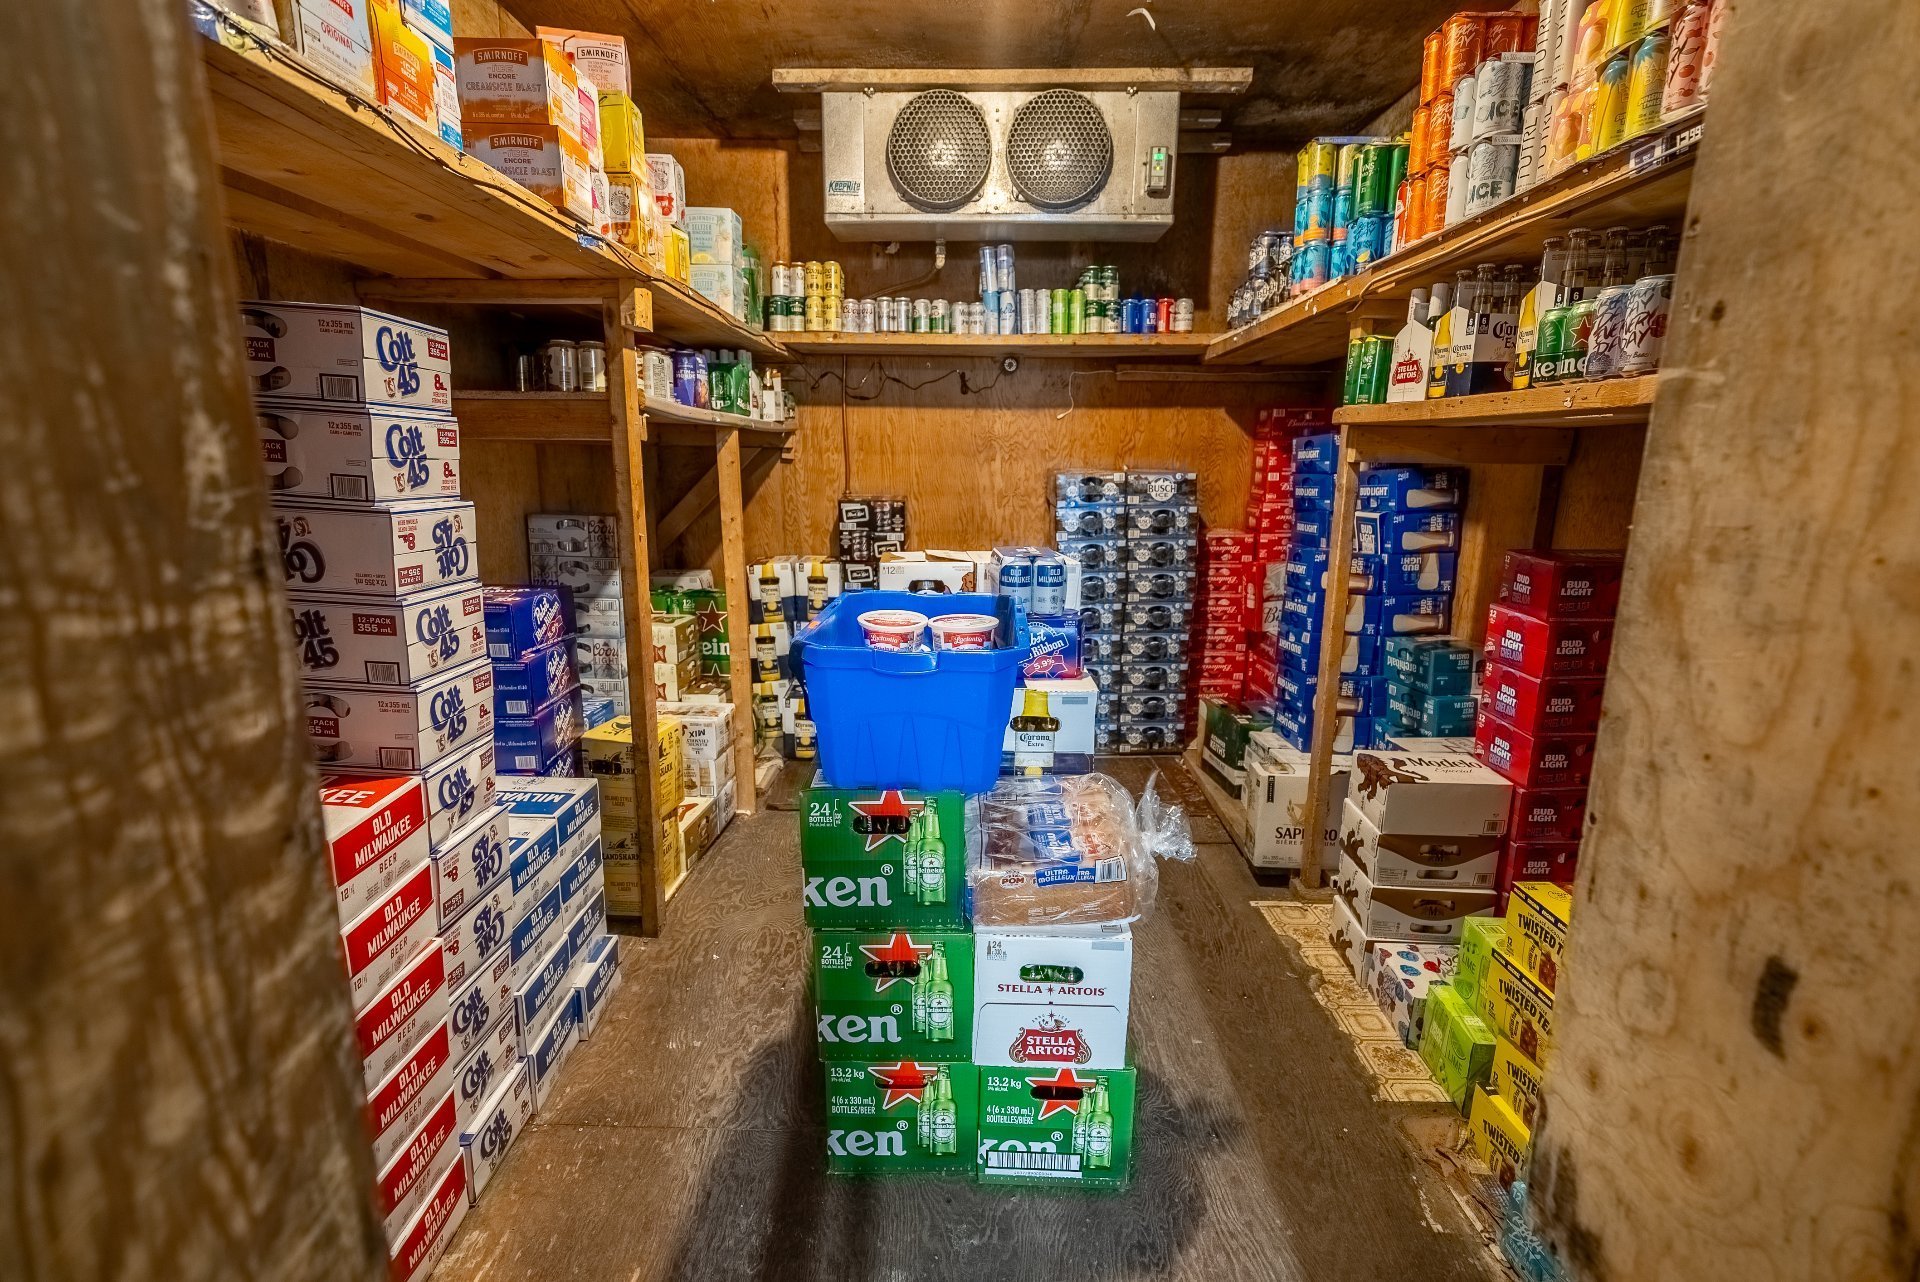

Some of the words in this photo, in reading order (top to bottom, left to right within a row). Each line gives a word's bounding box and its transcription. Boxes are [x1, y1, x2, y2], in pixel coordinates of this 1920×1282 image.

[478, 50, 523, 62] SMIRNOFF
[581, 50, 618, 60] SMIRNOFF
[516, 83, 542, 92] BLAST
[493, 135, 538, 147] SMIRNOFF
[530, 167, 556, 177] BLAST
[1472, 180, 1502, 203] ICE
[1574, 292, 1579, 300] 6
[376, 326, 416, 372] Colt
[1452, 344, 1472, 353] Corona
[1396, 372, 1416, 380] ARTOIS
[1398, 364, 1417, 372] STELLA
[398, 362, 420, 397] 45
[386, 424, 425, 468] Colt
[1298, 450, 1307, 459] BUD
[1306, 450, 1319, 458] LIGHT
[407, 454, 430, 490] 45
[1148, 484, 1176, 492] BUSCH
[1370, 487, 1388, 495] LIGHT
[432, 516, 453, 554] 45
[1361, 524, 1372, 534] BUD
[1360, 533, 1375, 543] LIGHT
[437, 537, 468, 579] Colt
[1002, 575, 1030, 583] MILWAUKEE
[358, 624, 378, 632] 355
[417, 604, 453, 646] Colt
[1506, 630, 1521, 641] BUD
[439, 628, 459, 662] 45
[1032, 640, 1064, 658] Ribbon
[1502, 638, 1523, 652] LIGHT
[304, 638, 339, 670] 45
[1034, 658, 1054, 671] 5.9%
[1501, 684, 1515, 697] BUD
[430, 685, 463, 731] Colt
[1497, 692, 1517, 707] LIGHT
[689, 729, 706, 738] MIX
[1020, 733, 1051, 743] Corona
[1406, 757, 1482, 769] Modelo
[438, 766, 472, 810] Colt
[575, 800, 584, 814] OLD
[810, 803, 830, 816] 24
[1533, 808, 1554, 816] BUD
[372, 809, 391, 835] OLD
[567, 803, 593, 835] MILWAUKEE
[354, 815, 411, 869] MILWAUKEE
[527, 845, 539, 862] OLD
[379, 852, 397, 874] BEER
[474, 842, 502, 889] Colt
[517, 848, 550, 887] MILWAUKEE
[341, 888, 349, 902] 12
[384, 896, 402, 922] OLD
[531, 908, 542, 926] OLD
[367, 897, 421, 958] MILWAUKEE
[521, 908, 554, 952] MILWAUKEE
[1518, 913, 1556, 948] TWISTED
[390, 936, 407, 959] BEER
[822, 946, 842, 958] 24
[391, 981, 410, 1008] OLD
[997, 984, 1042, 994] STELLA
[1058, 987, 1105, 996] ARTOIS
[1499, 978, 1536, 1018] TWISTED
[372, 979, 430, 1046] MILWAUKEE
[397, 1018, 416, 1043] BEER
[1026, 1036, 1075, 1046] STELLA
[1026, 1046, 1076, 1056] ARTOIS
[399, 1060, 418, 1089] OLD
[830, 1068, 852, 1077] 13.2
[854, 1070, 865, 1079] kg
[988, 1077, 1008, 1086] 13.2
[1010, 1079, 1021, 1089] kg
[380, 1057, 437, 1128] MILWAUKEE
[863, 1096, 876, 1105] mL)
[404, 1097, 422, 1122] BEER
[831, 1106, 875, 1114] BOTTLES/BEER
[1021, 1107, 1034, 1116] mL)
[481, 1108, 508, 1161] Colt
[1482, 1119, 1519, 1164] TWISTED
[410, 1132, 427, 1162] OLD
[393, 1125, 445, 1202] MILWAUKEE
[424, 1198, 440, 1229] OLD
[409, 1188, 456, 1269] MILWAUKEE
